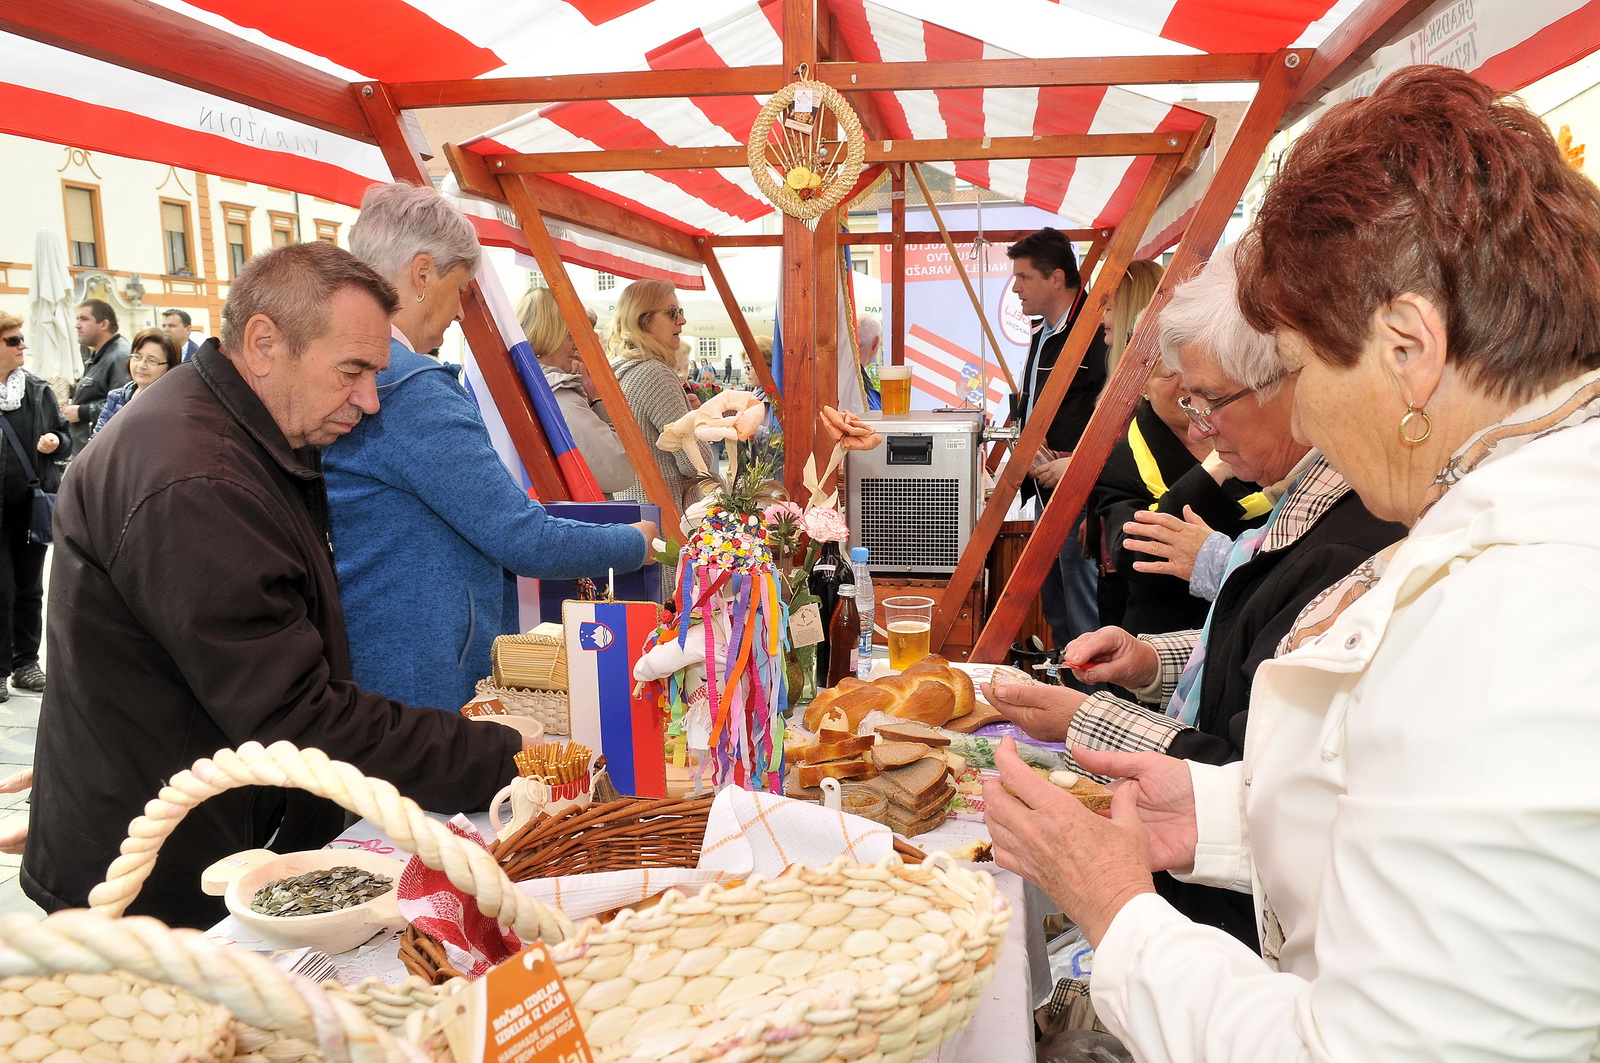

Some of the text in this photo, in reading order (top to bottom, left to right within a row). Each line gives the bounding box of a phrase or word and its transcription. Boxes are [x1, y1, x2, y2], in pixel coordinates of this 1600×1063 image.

[493, 979, 560, 1032] ROČNO IZDELAN
[540, 1007, 571, 1036] PRODUCT
[495, 1014, 533, 1046] IZDELEK
[531, 1006, 542, 1022] IZ
[555, 1017, 576, 1038] HUSK
